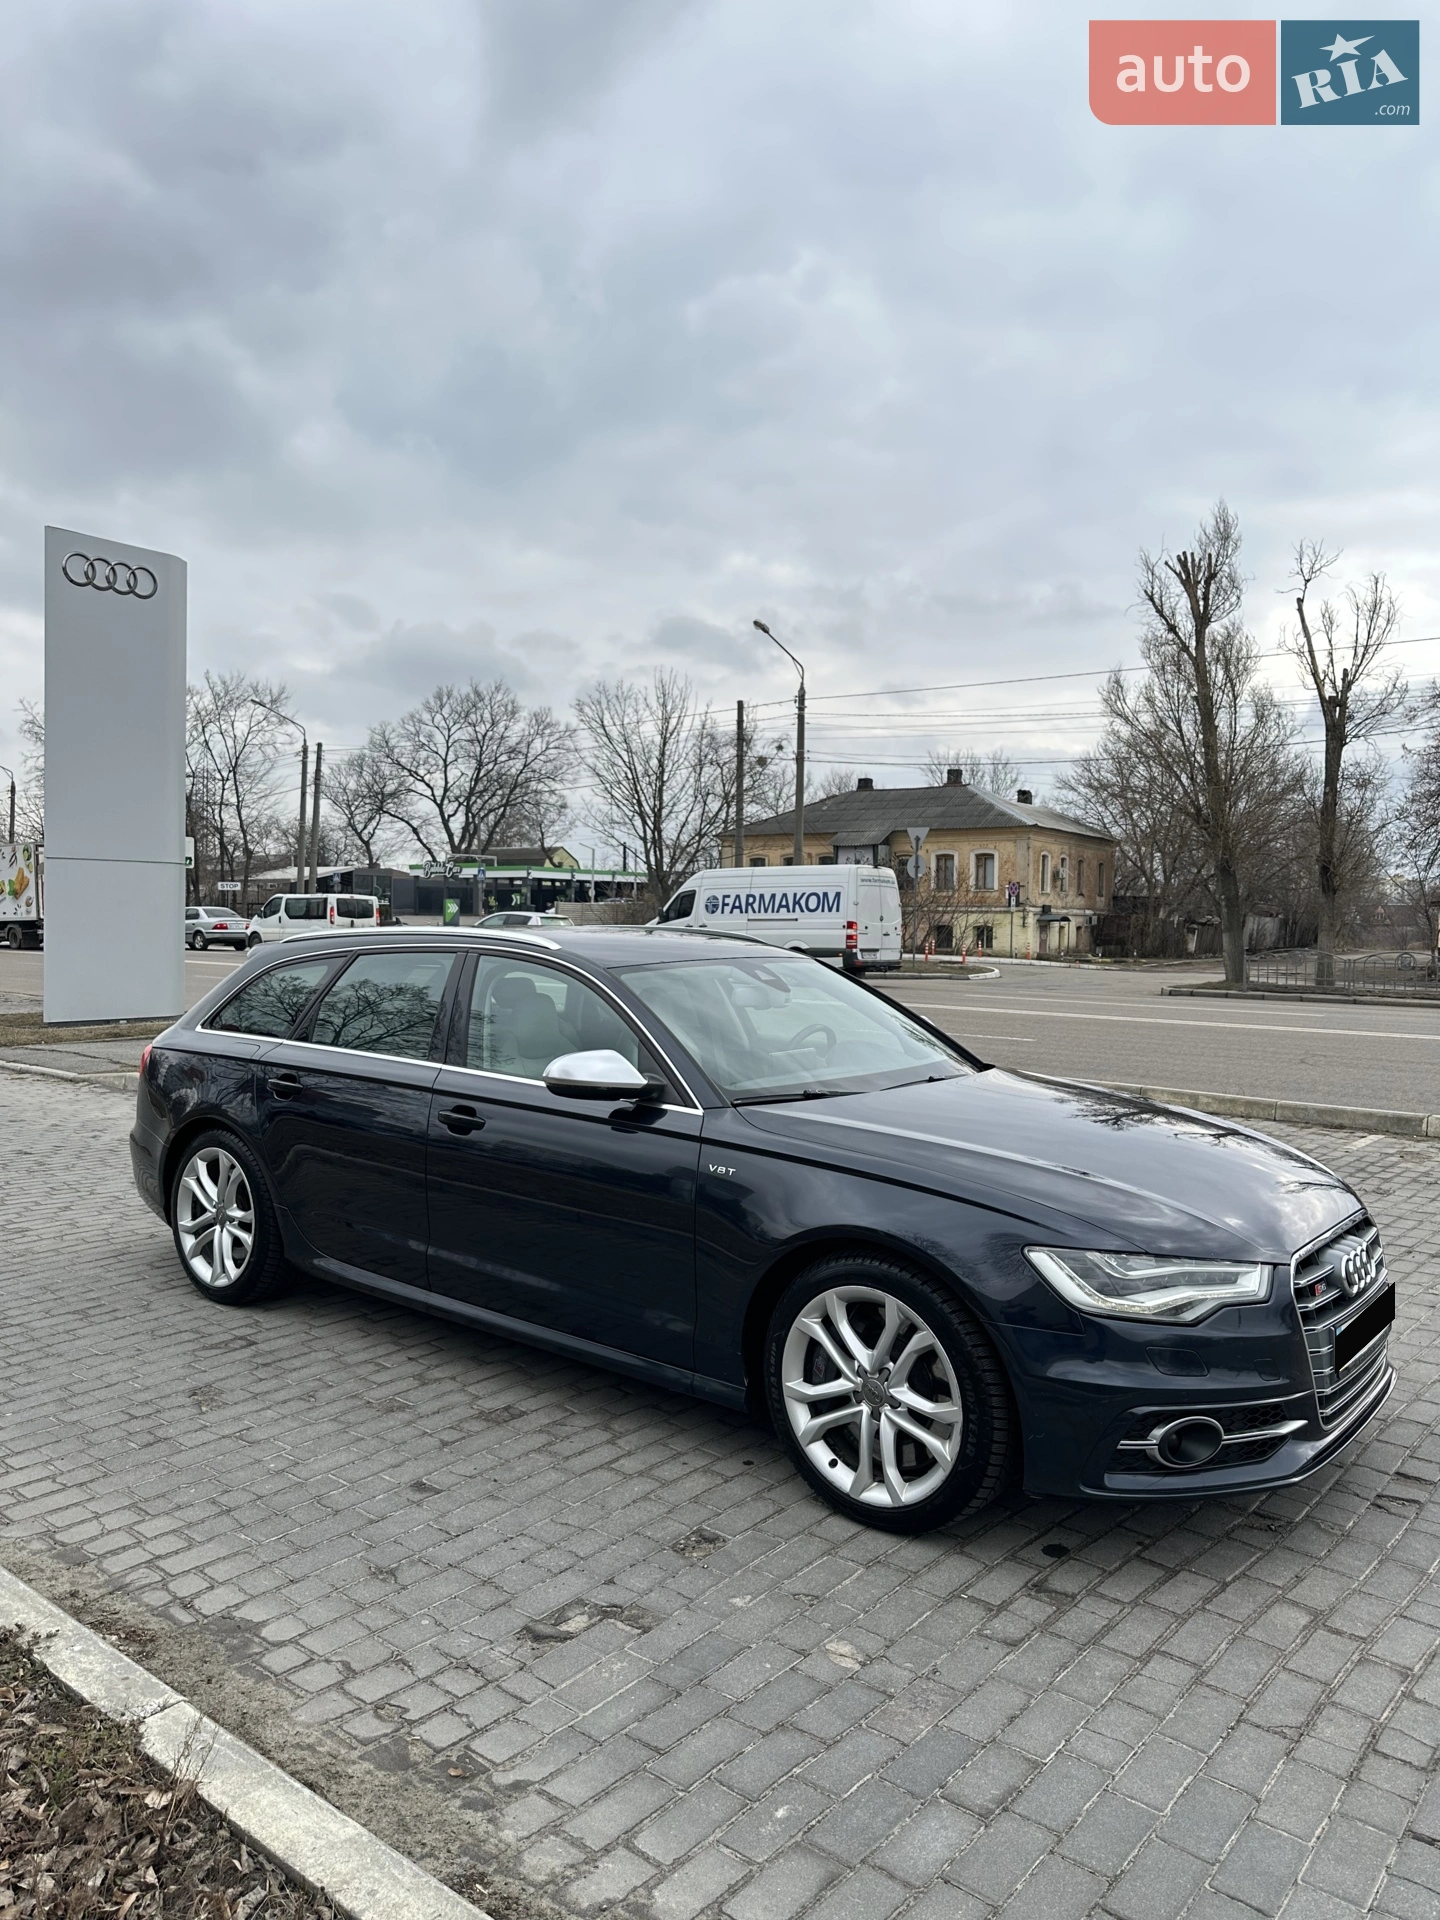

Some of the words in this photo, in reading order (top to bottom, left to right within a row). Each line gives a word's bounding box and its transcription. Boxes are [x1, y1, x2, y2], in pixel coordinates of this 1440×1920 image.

[720, 891, 842, 914] FARMAKOM
[708, 1164, 737, 1176] V8T
[769, 1342, 777, 1373] GRIP
